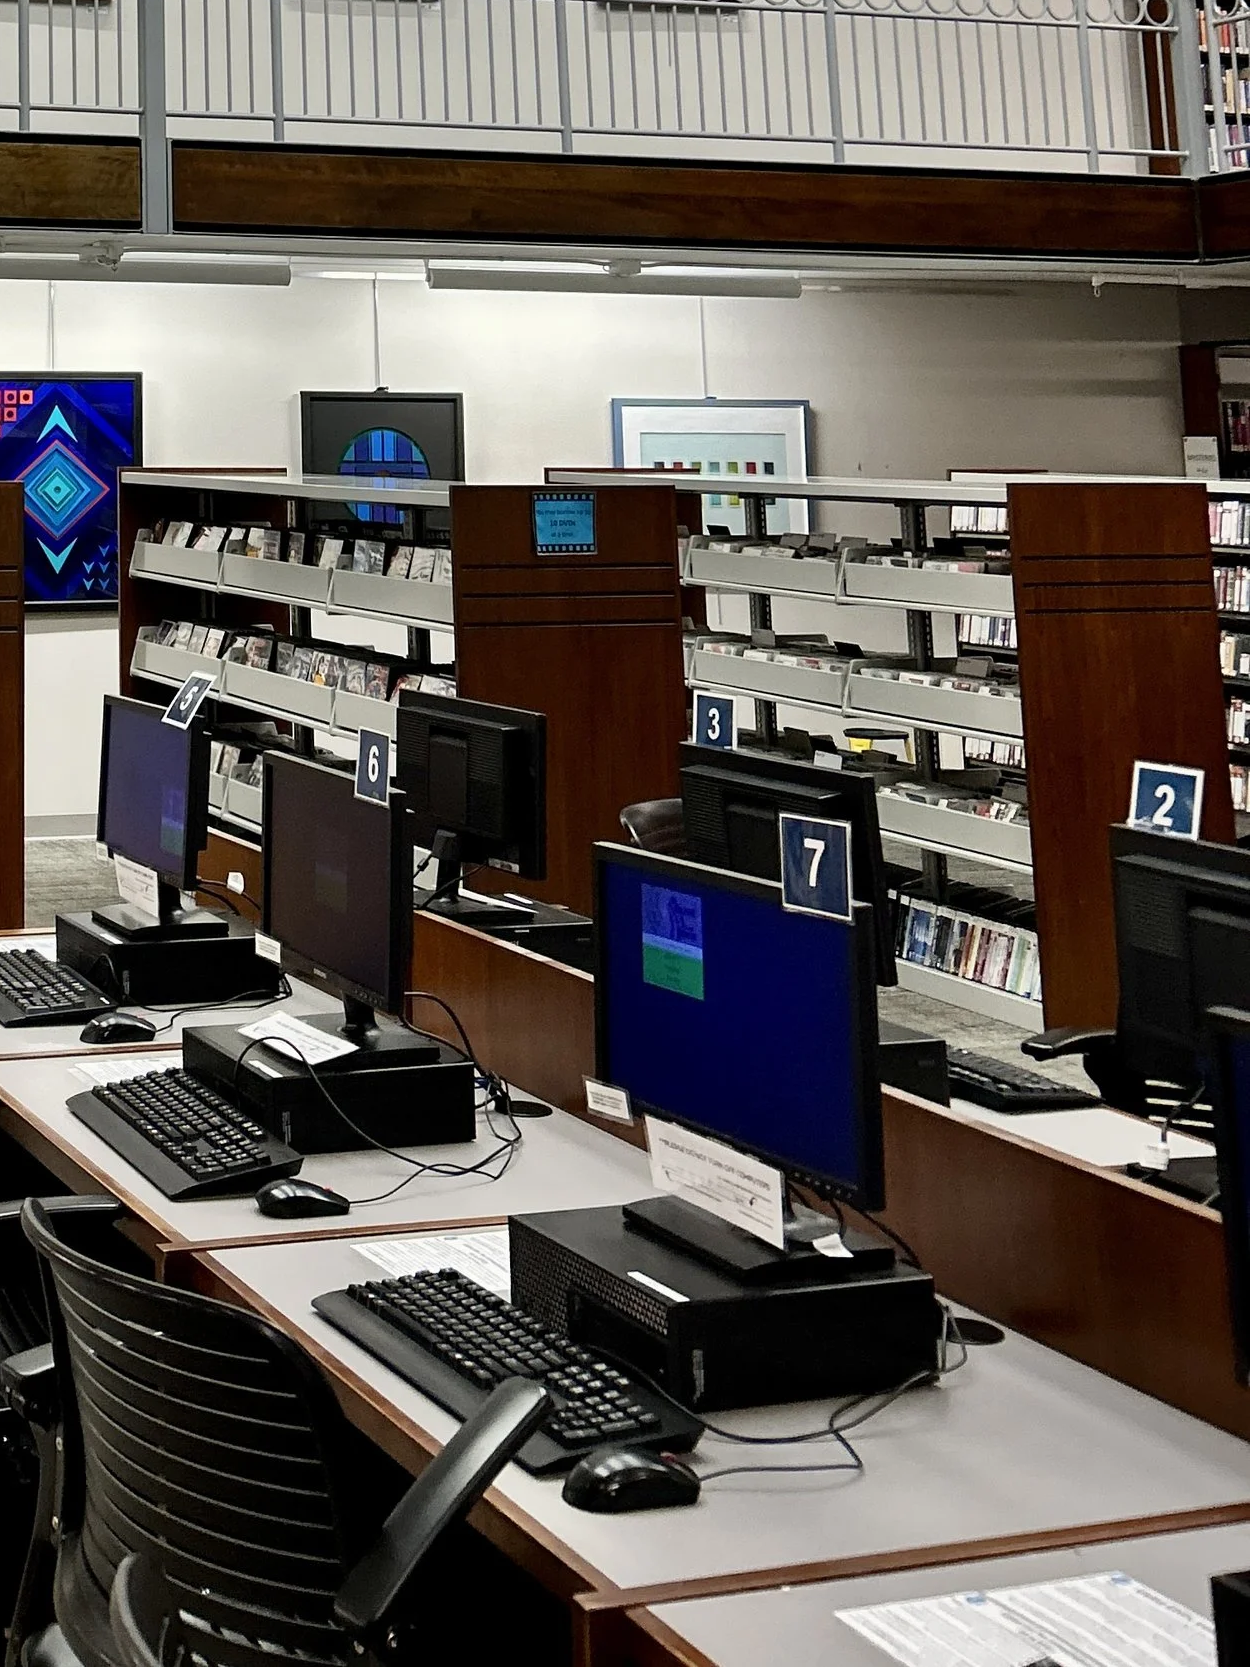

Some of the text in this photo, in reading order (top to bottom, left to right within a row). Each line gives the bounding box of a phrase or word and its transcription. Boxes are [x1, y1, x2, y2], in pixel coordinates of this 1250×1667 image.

[179, 686, 199, 711] 5
[707, 707, 720, 740] 3
[368, 744, 379, 783] 6
[1152, 784, 1176, 827] 2
[803, 838, 825, 887] 7
